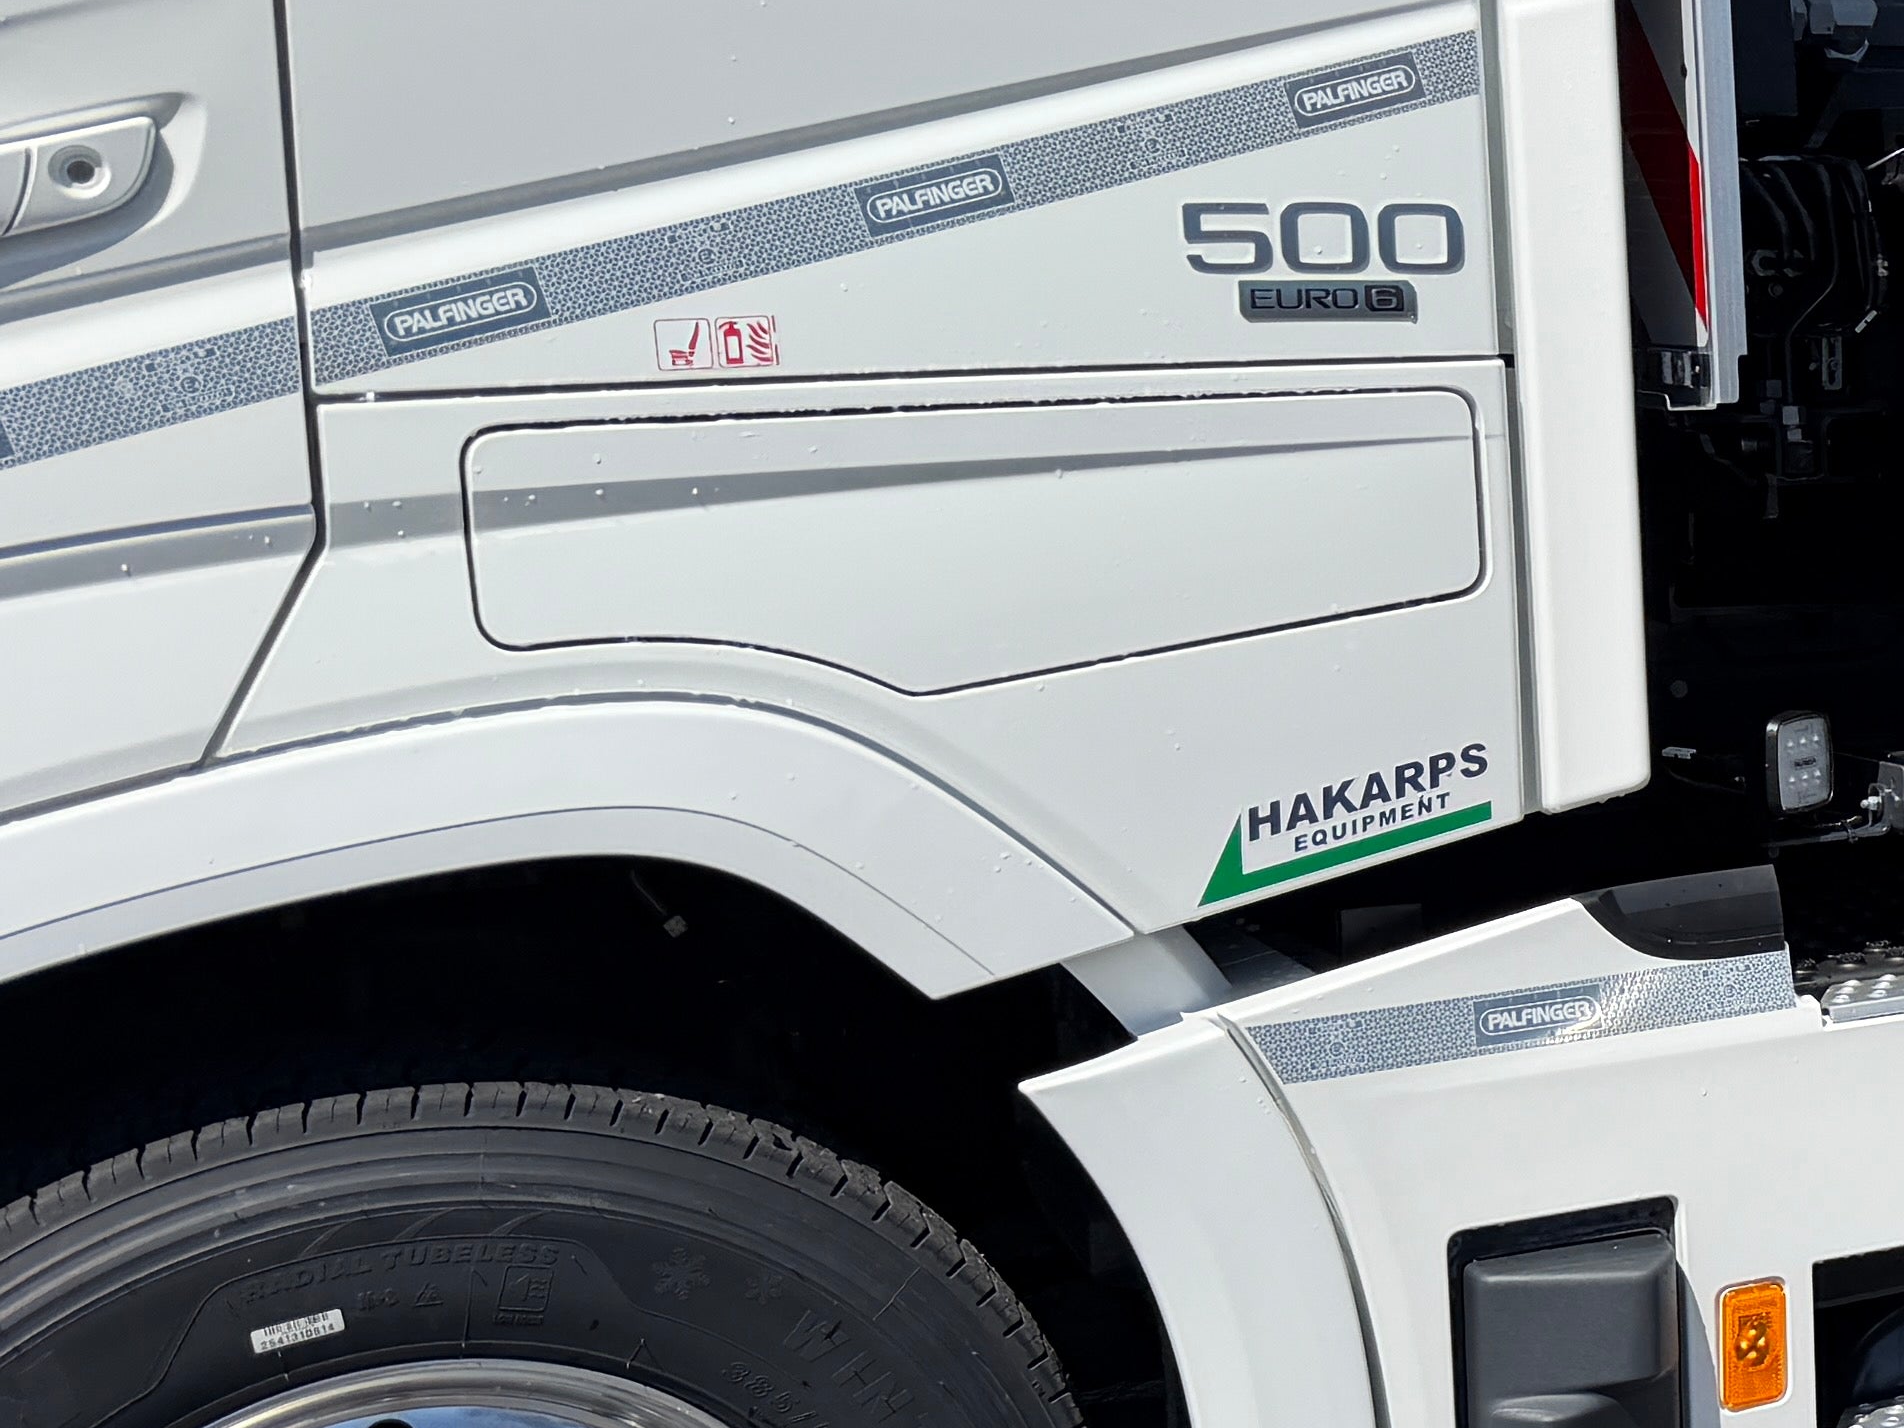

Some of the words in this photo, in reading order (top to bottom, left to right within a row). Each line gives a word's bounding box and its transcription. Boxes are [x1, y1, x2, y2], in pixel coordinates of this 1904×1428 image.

[1302, 70, 1409, 113] PALFINGER
[874, 173, 995, 220] PALFINGER
[1182, 201, 1466, 275] 500
[392, 286, 528, 338] PALFINGER
[1248, 743, 1489, 842] HAKARPS
[1293, 790, 1451, 853] EQUIPMENT
[1486, 1000, 1597, 1031] PALFINGER
[378, 1243, 560, 1270] TUBELESS
